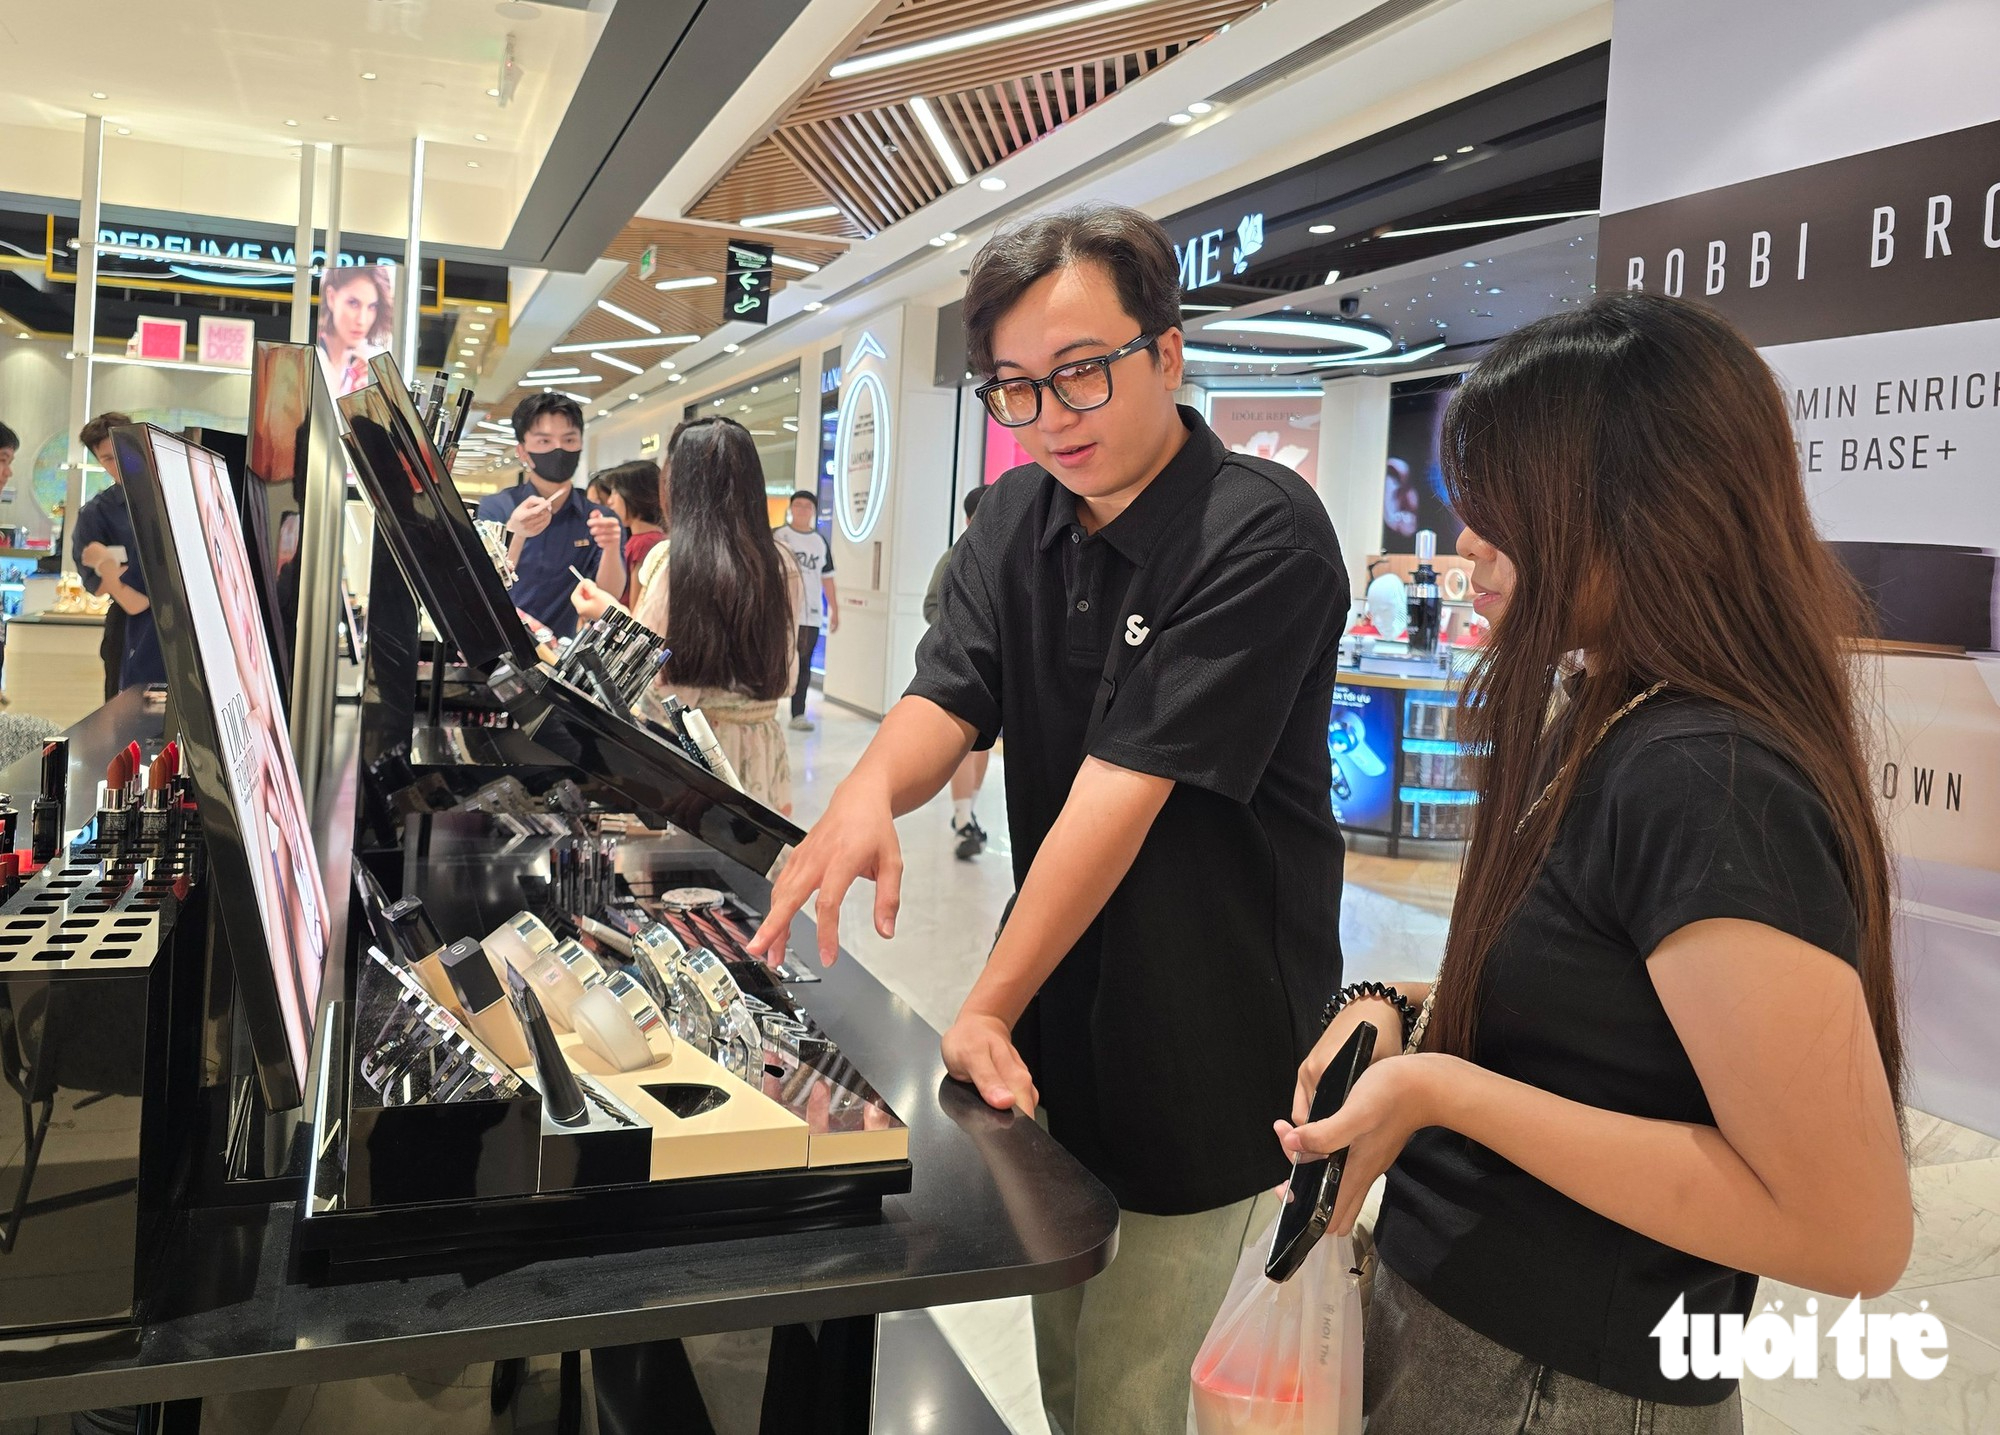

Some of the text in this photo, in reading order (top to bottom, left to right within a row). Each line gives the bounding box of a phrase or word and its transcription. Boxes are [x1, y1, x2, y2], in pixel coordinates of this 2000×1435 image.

[98, 229, 262, 267] PERFUME
[1627, 222, 1808, 297] BOBBI
[1841, 435, 1957, 472] BASE+
[221, 692, 252, 764] DIOR
[1882, 762, 1962, 812] OWN
